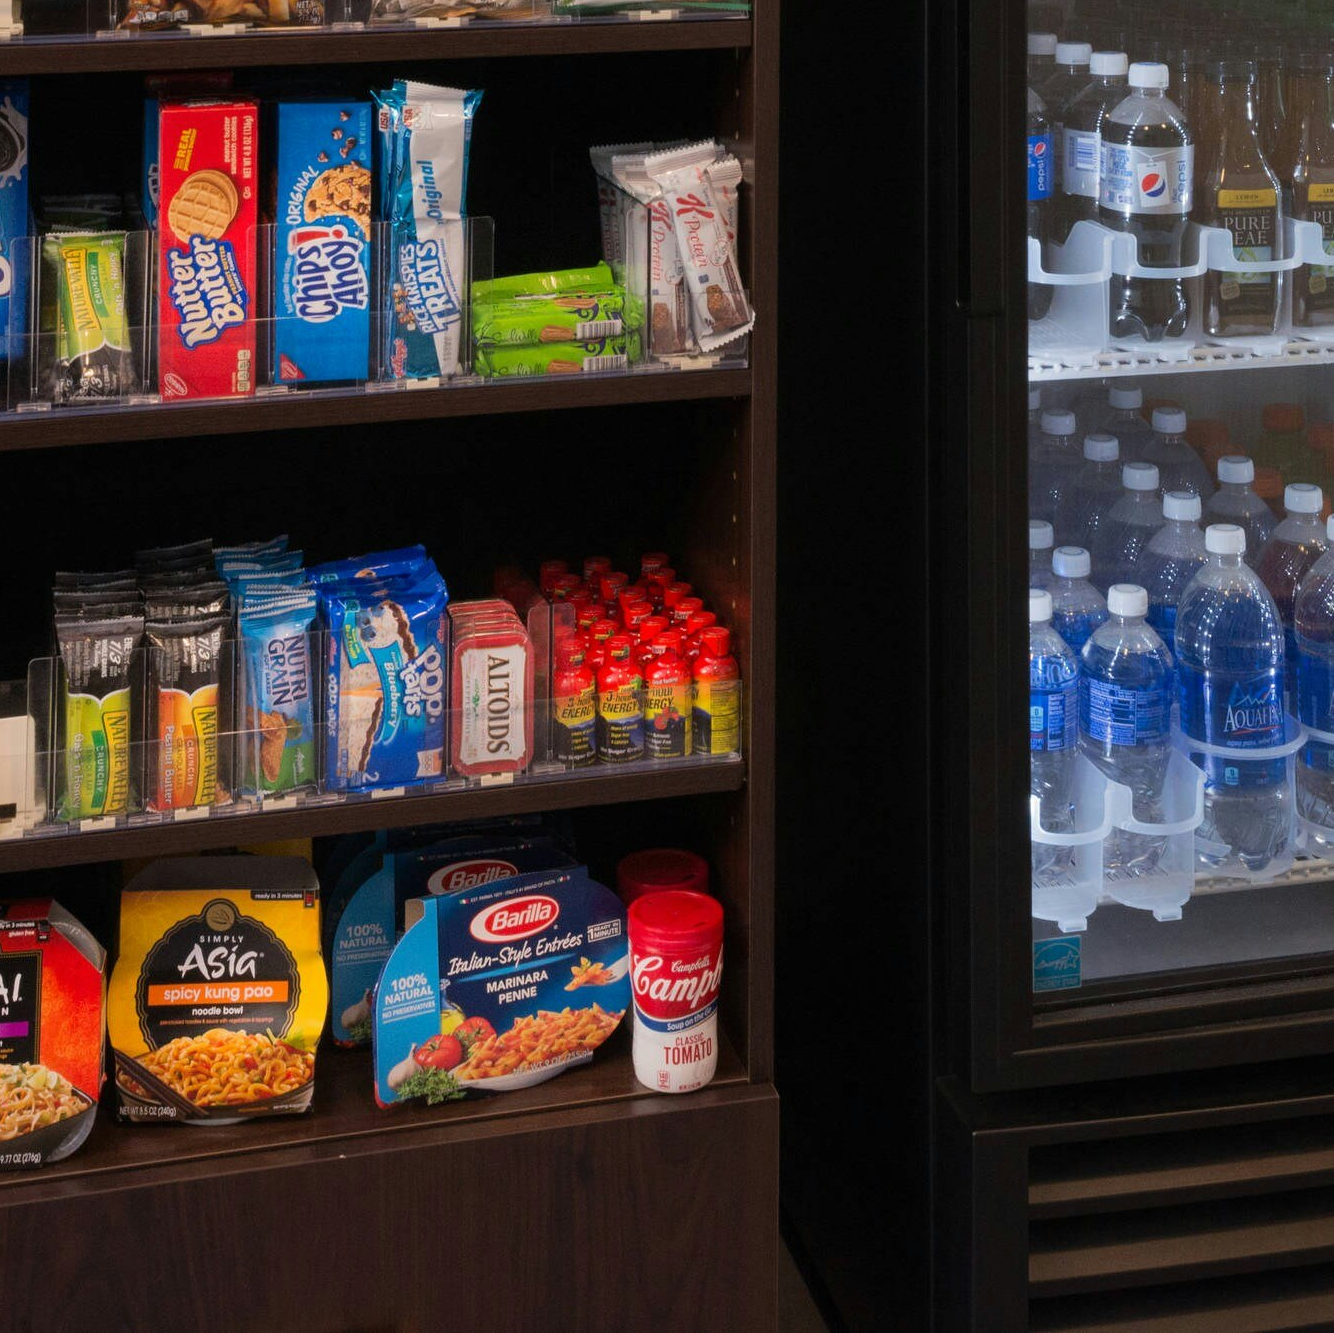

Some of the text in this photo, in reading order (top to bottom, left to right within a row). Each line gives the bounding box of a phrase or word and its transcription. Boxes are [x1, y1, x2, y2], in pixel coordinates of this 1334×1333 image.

[379, 110, 389, 129] USA
[176, 128, 191, 158] REAL
[418, 160, 443, 219] Original
[1037, 159, 1046, 192] pepsi
[1176, 159, 1187, 204] pepsi
[285, 166, 320, 225] ORIGINAL
[1223, 216, 1271, 231] PURE
[651, 228, 666, 282] Protein
[683, 217, 709, 270] Protein
[89, 263, 101, 306] CRUNCHY
[170, 250, 217, 347] Nutter
[192, 238, 244, 327] Butter
[293, 243, 338, 318] Chips
[400, 244, 433, 333] RICE KRISPIES
[416, 239, 460, 334] TREATS
[392, 338, 407, 379] Kellogg's
[268, 638, 292, 707] GRAIN
[284, 634, 307, 702] NUTRI
[383, 661, 399, 728] Blueberry
[484, 654, 512, 755] ALTOIDS
[602, 700, 639, 714] ENERGY
[112, 715, 129, 766] NATURE
[200, 710, 218, 757] NATURE
[95, 744, 104, 794] CRUNCHY
[163, 725, 175, 804] Peanut Butter
[185, 739, 195, 787] CRUNCHY
[345, 923, 384, 937] 100%
[491, 904, 553, 932] Barilla
[593, 927, 619, 939] MINUTE
[200, 935, 244, 944] SIMPLY
[339, 935, 389, 949] NATURAL
[448, 932, 584, 976] Italian-Style Entrées
[178, 945, 257, 980] Asia
[162, 985, 274, 1003] spicy kung pao
[384, 985, 435, 1006] NATURAL
[391, 973, 428, 992] 100%
[486, 970, 549, 994] MARINARA
[498, 988, 538, 1004] PENNE
[191, 1005, 244, 1017] noodle bowl
[382, 1000, 436, 1019] NO PRESERVATIVES
[666, 1021, 684, 1033] Soup
[663, 1042, 713, 1066] TOMATO
[674, 1032, 704, 1047] CLASSIC
[22, 1152, 42, 1164] (276g)
